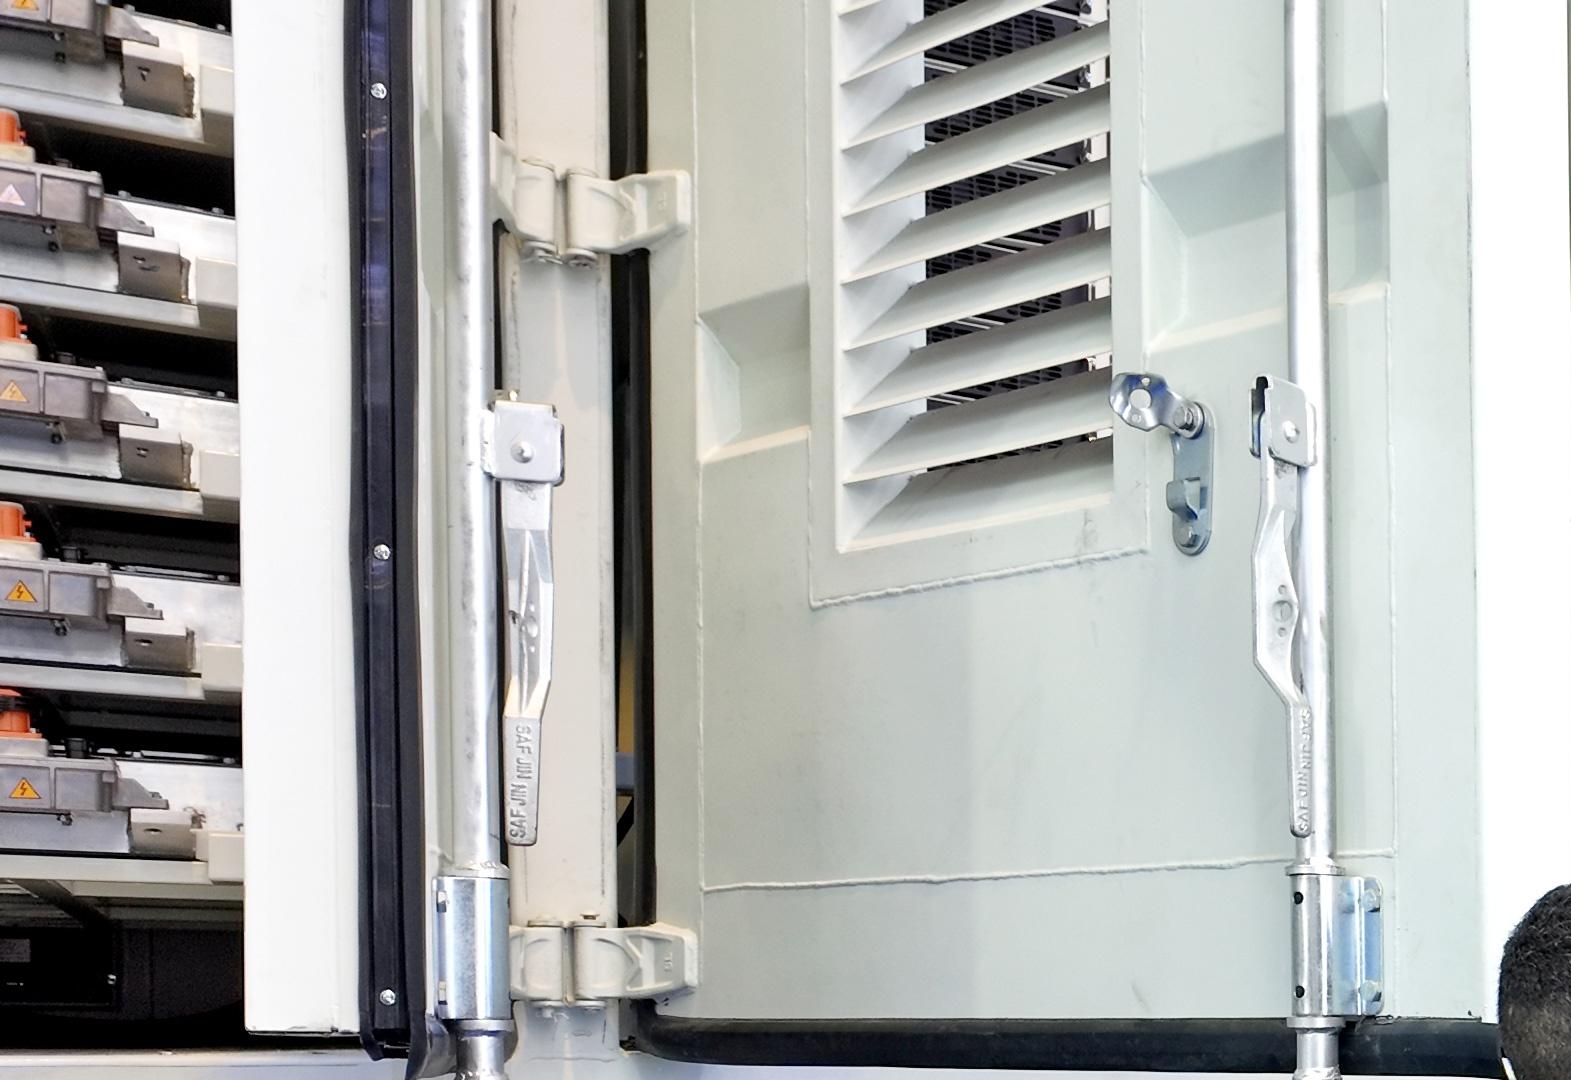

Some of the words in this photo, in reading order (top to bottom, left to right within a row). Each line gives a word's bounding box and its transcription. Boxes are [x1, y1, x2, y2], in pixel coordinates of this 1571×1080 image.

[515, 725, 532, 755] SAF
[515, 757, 533, 780] JIN
[510, 783, 527, 807] JIN
[1296, 770, 1308, 797] JIN
[508, 808, 527, 839] SAF
[1297, 800, 1309, 832] SAF
